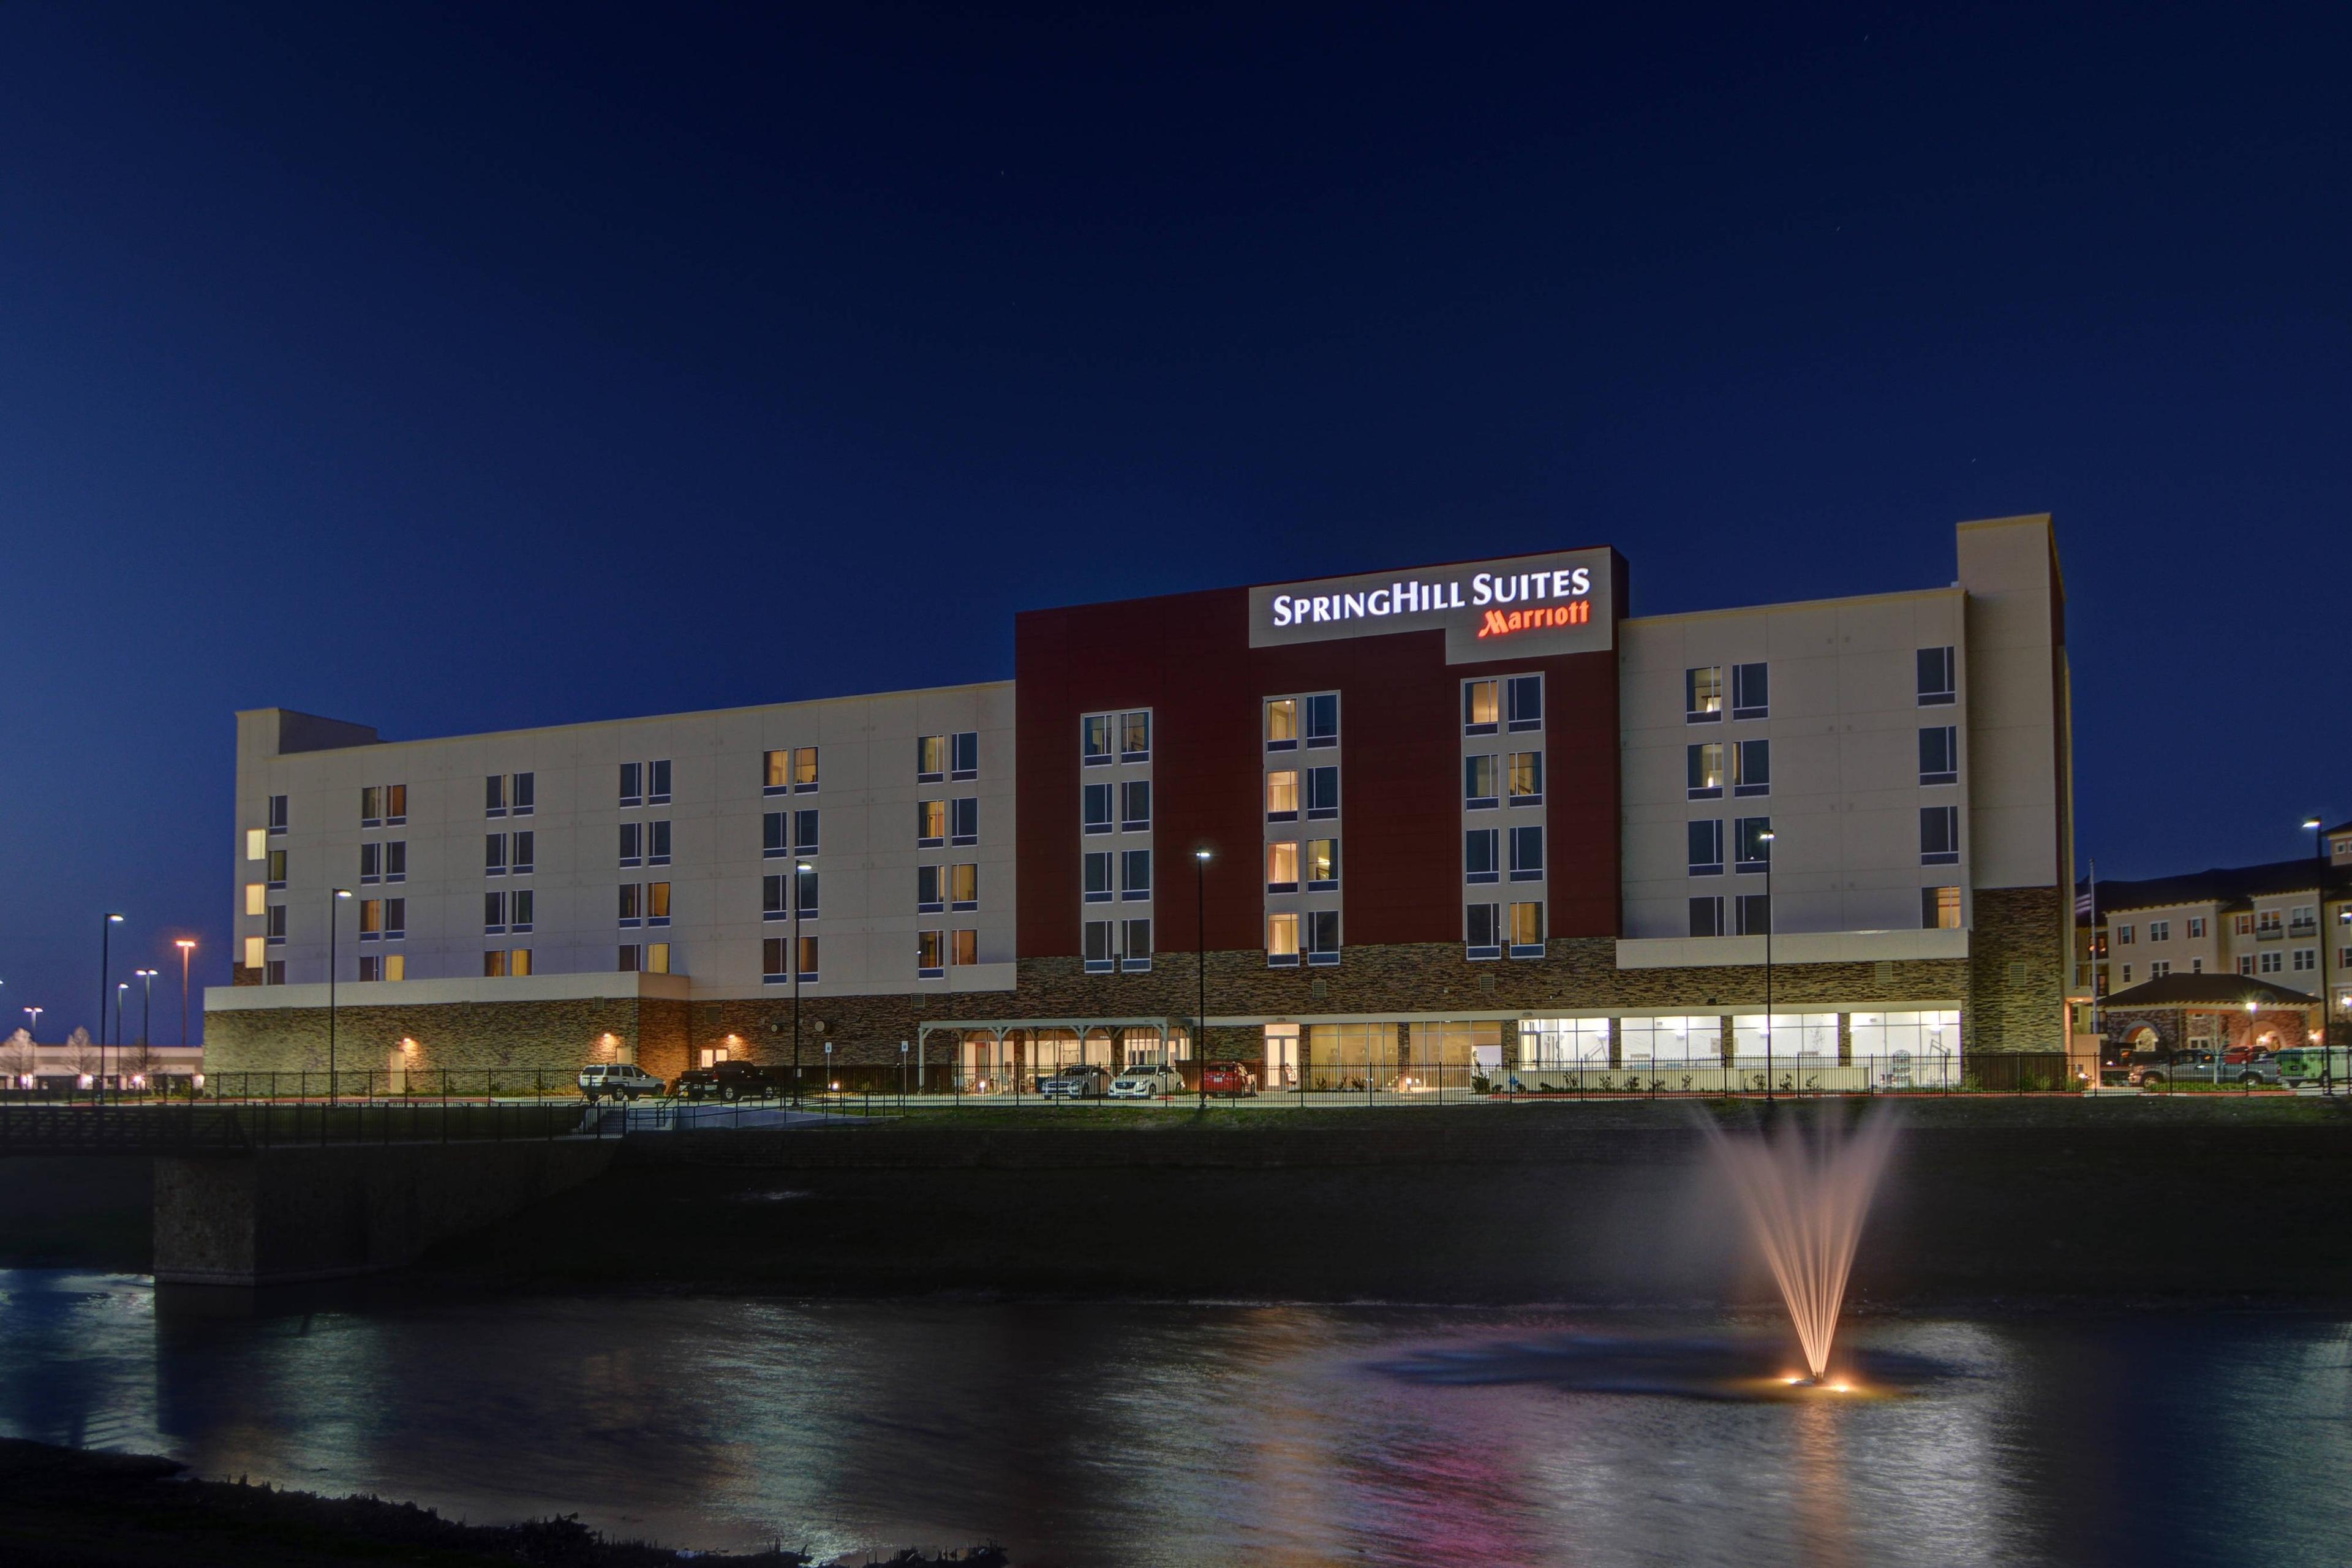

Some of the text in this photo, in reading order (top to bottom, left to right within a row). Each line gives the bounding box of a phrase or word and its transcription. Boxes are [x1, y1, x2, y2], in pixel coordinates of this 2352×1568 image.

[1273, 567, 1591, 627] SPRINGHILL SUITES
[1478, 600, 1589, 638] Marriott
